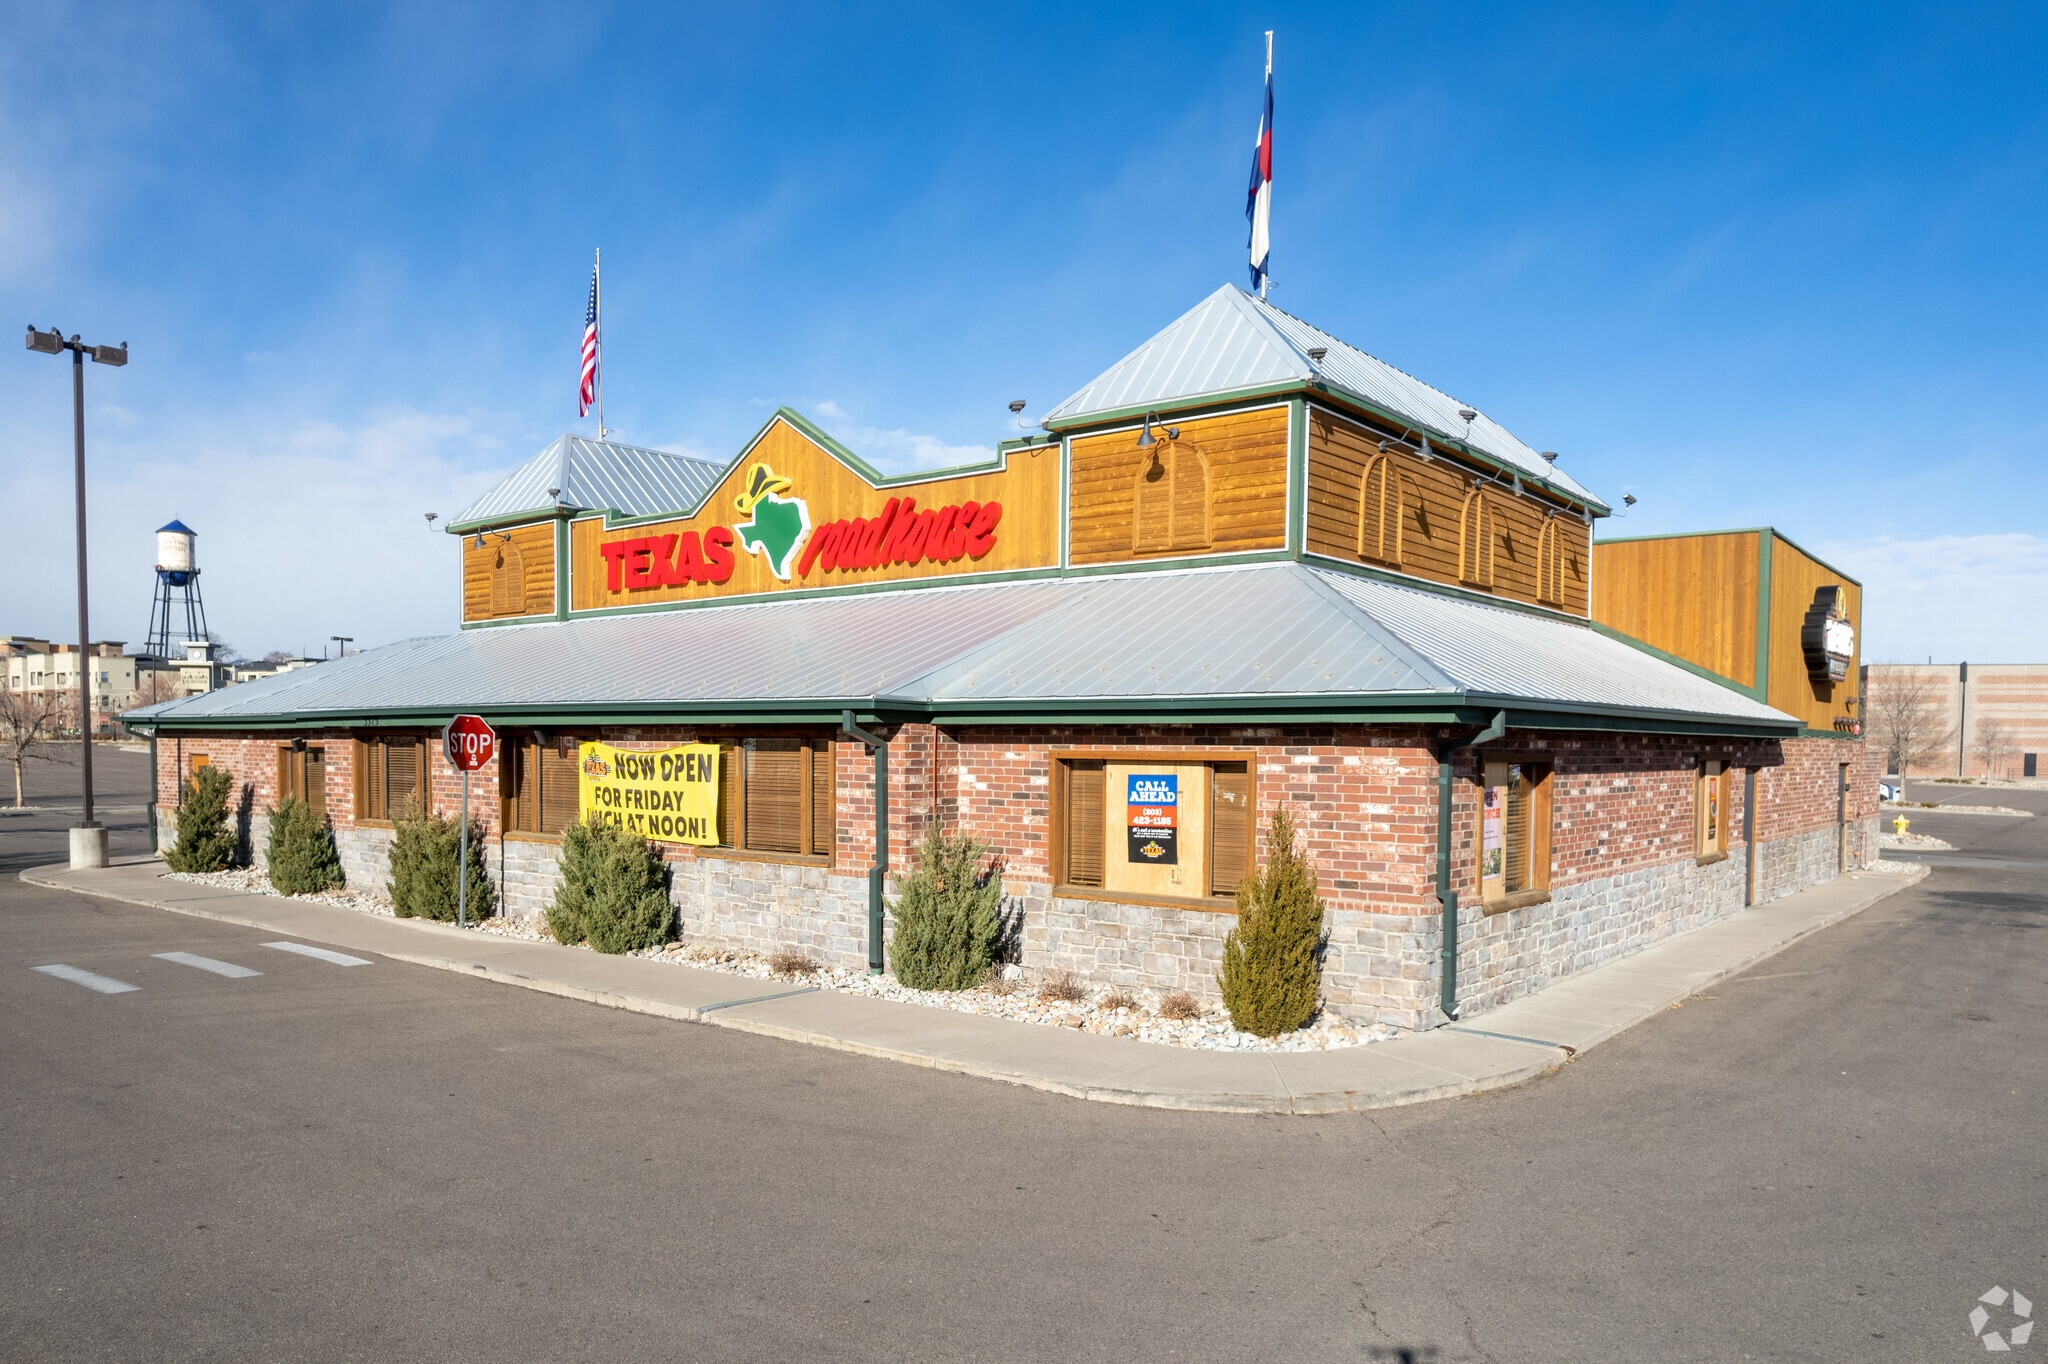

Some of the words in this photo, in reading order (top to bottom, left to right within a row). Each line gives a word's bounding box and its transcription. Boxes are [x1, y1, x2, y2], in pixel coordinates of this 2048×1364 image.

[600, 525, 735, 592] TEXAS
[797, 496, 1003, 577] roadhouse
[450, 732, 491, 754] STOP
[614, 753, 656, 780] NOW
[660, 753, 713, 783] OPEN
[1129, 791, 1176, 802] AHEAD
[1135, 781, 1169, 791] CALL
[595, 786, 622, 808] FOR
[625, 788, 684, 812] FRIDAY
[648, 815, 707, 839] NOON!
